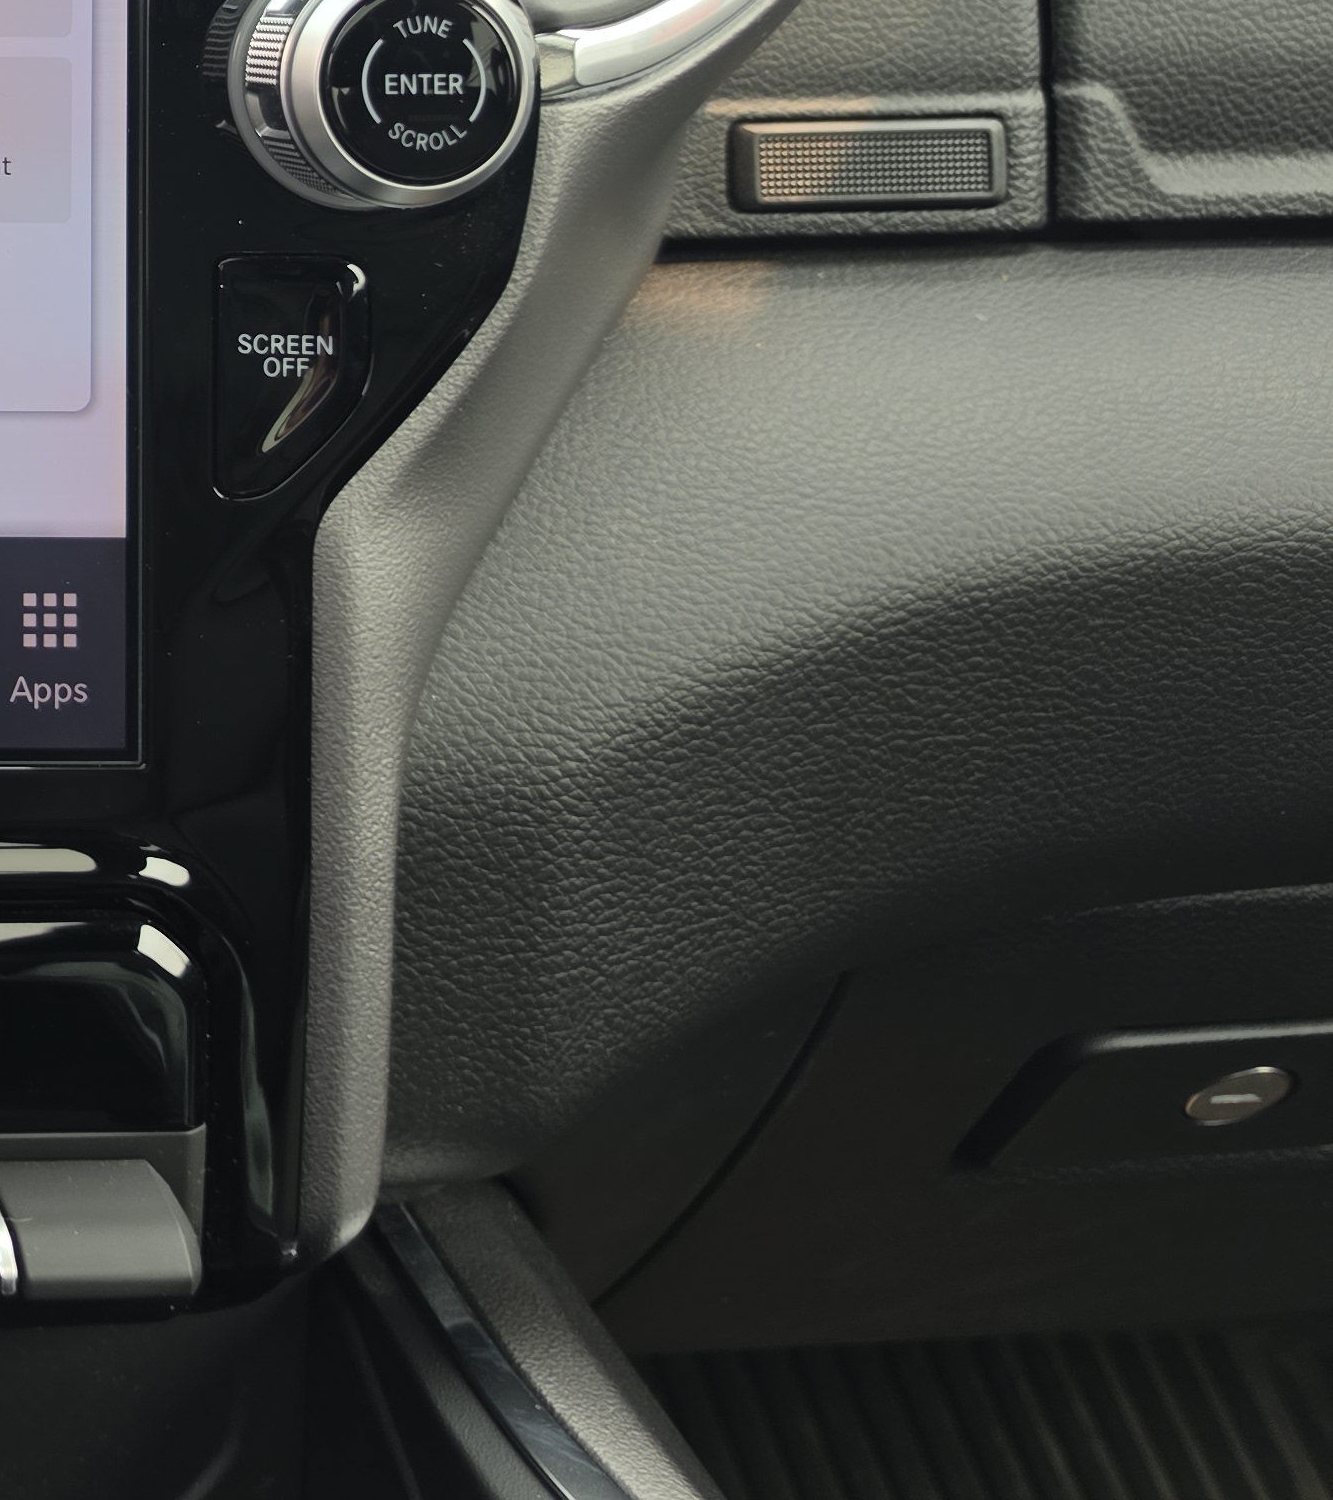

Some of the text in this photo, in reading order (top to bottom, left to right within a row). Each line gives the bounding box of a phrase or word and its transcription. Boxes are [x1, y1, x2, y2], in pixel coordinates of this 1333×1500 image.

[393, 16, 452, 38] TUNE
[384, 73, 464, 95] ENTER
[388, 122, 467, 151] SCROLL
[237, 333, 334, 355] SCREEN
[263, 357, 310, 377] OFF
[9, 675, 88, 710] Apps
